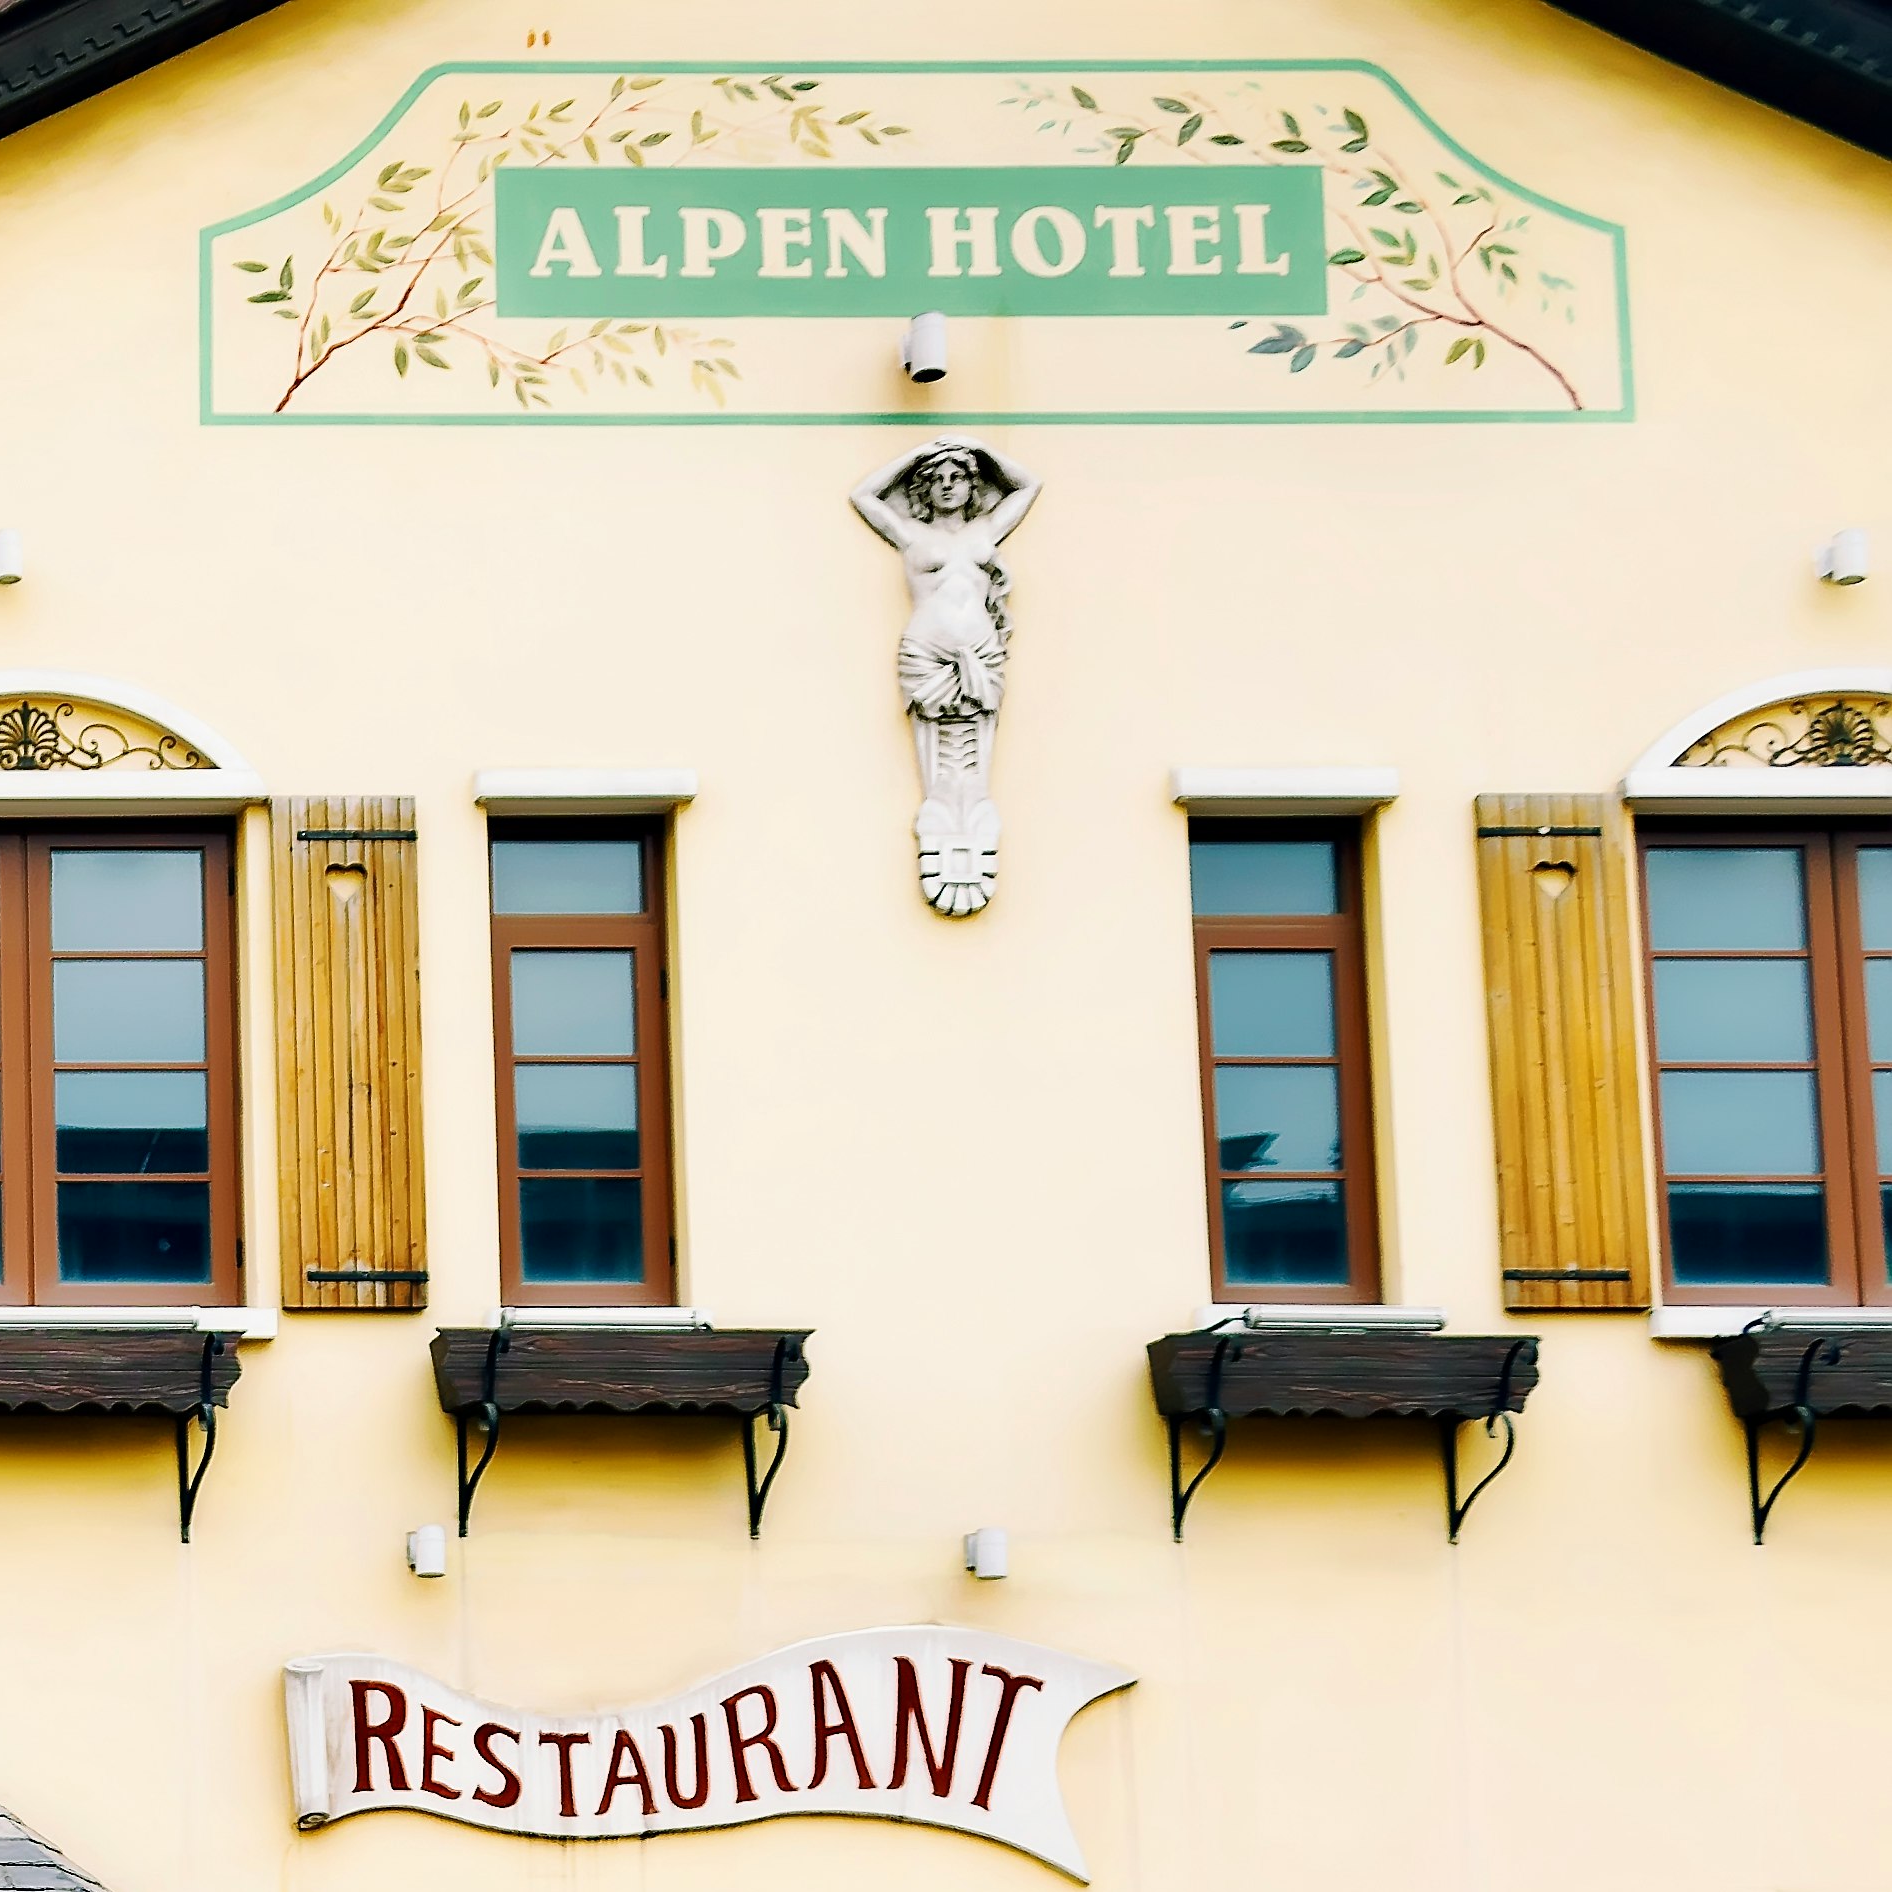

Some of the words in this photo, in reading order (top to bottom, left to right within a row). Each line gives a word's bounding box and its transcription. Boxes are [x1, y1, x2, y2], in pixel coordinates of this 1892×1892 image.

[528, 206, 890, 280] ALPEN
[924, 204, 1292, 279] HOTEL
[347, 1655, 1045, 1818] RESTAURANT
